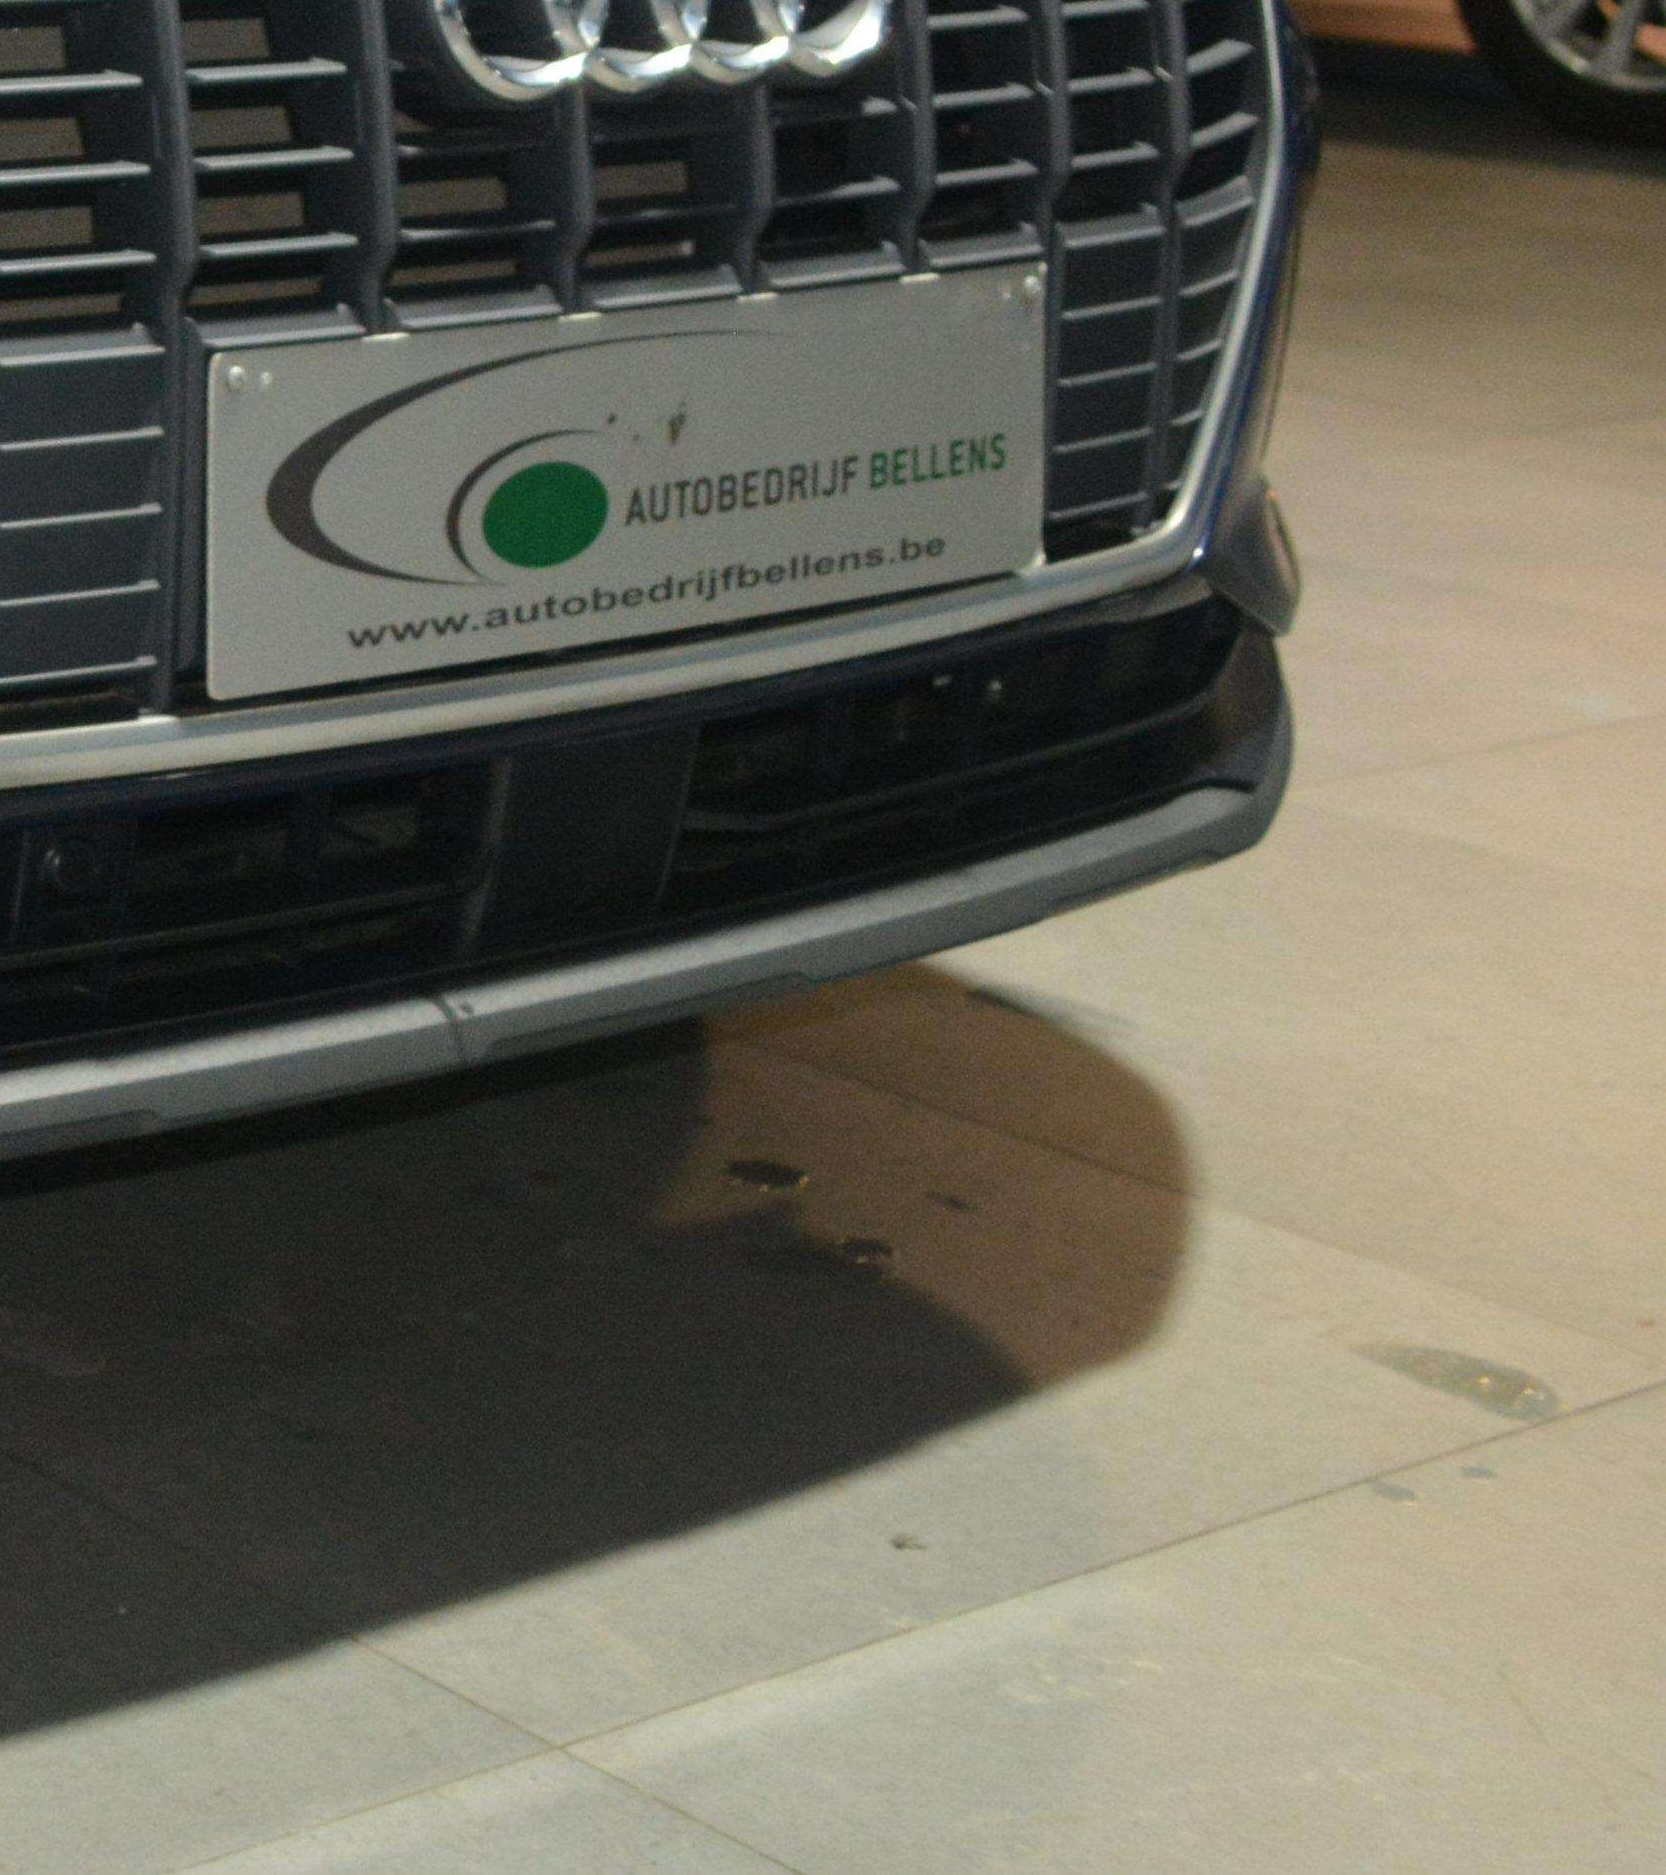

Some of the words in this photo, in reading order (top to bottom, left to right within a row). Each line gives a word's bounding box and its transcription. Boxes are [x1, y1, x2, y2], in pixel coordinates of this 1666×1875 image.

[625, 455, 859, 526] AUTOBEDRIJF
[869, 433, 1007, 489] BELLENS
[349, 535, 947, 648] www.autobedrijfbellens.be
